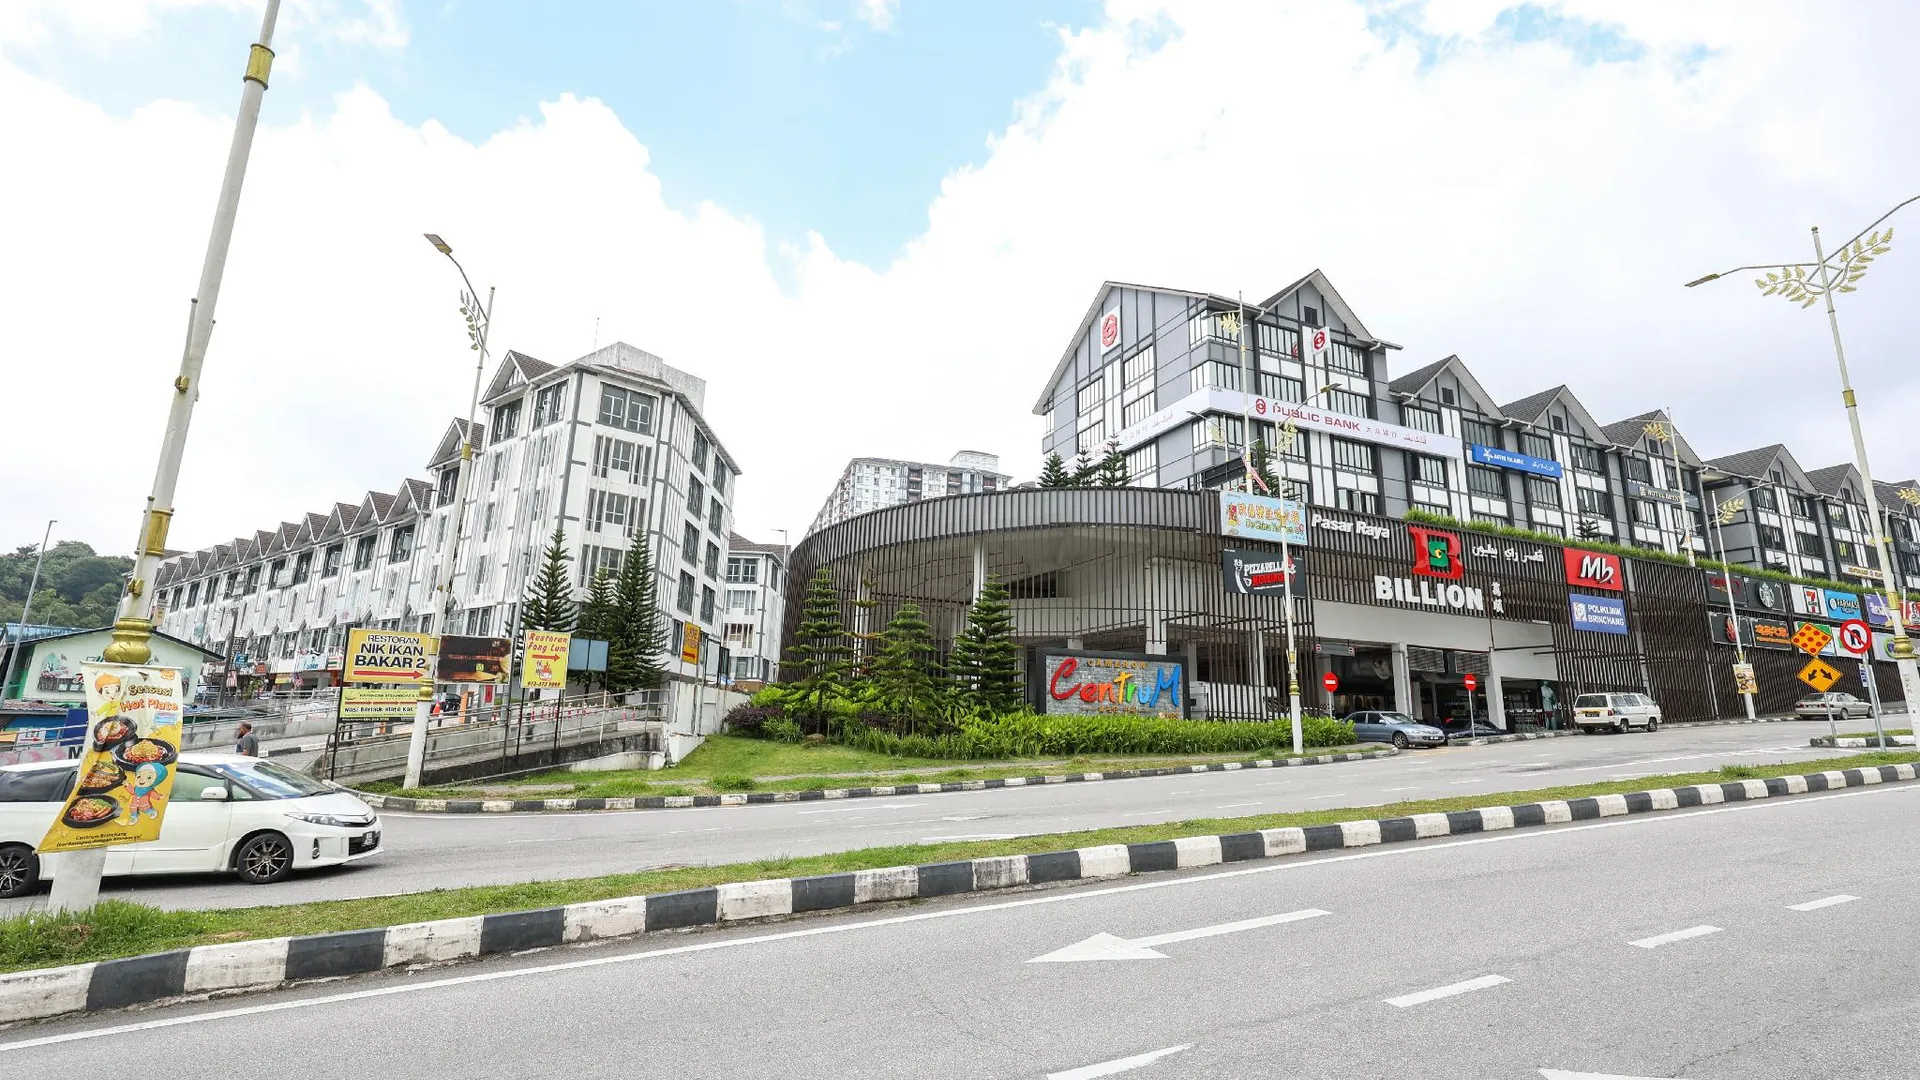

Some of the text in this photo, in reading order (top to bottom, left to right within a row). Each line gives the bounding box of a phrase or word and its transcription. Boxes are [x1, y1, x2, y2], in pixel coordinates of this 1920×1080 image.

[1272, 403, 1361, 432] PUBLIC BANK
[1311, 513, 1353, 533] Pasar
[1356, 520, 1390, 540] Raya
[1374, 575, 1484, 611] BILLION
[1587, 603, 1623, 616] POLIKLINIK
[1587, 614, 1625, 626] BRINCHANG
[367, 634, 420, 645] RESTORAN
[529, 632, 567, 643] Restoran
[360, 643, 424, 657] NIK IKAN
[528, 642, 567, 653] Fong Lum
[354, 655, 427, 669] BAKAR 2
[1087, 658, 1147, 669] CAMERON
[128, 684, 174, 697] Sensasi
[120, 698, 179, 712] Hot Plate
